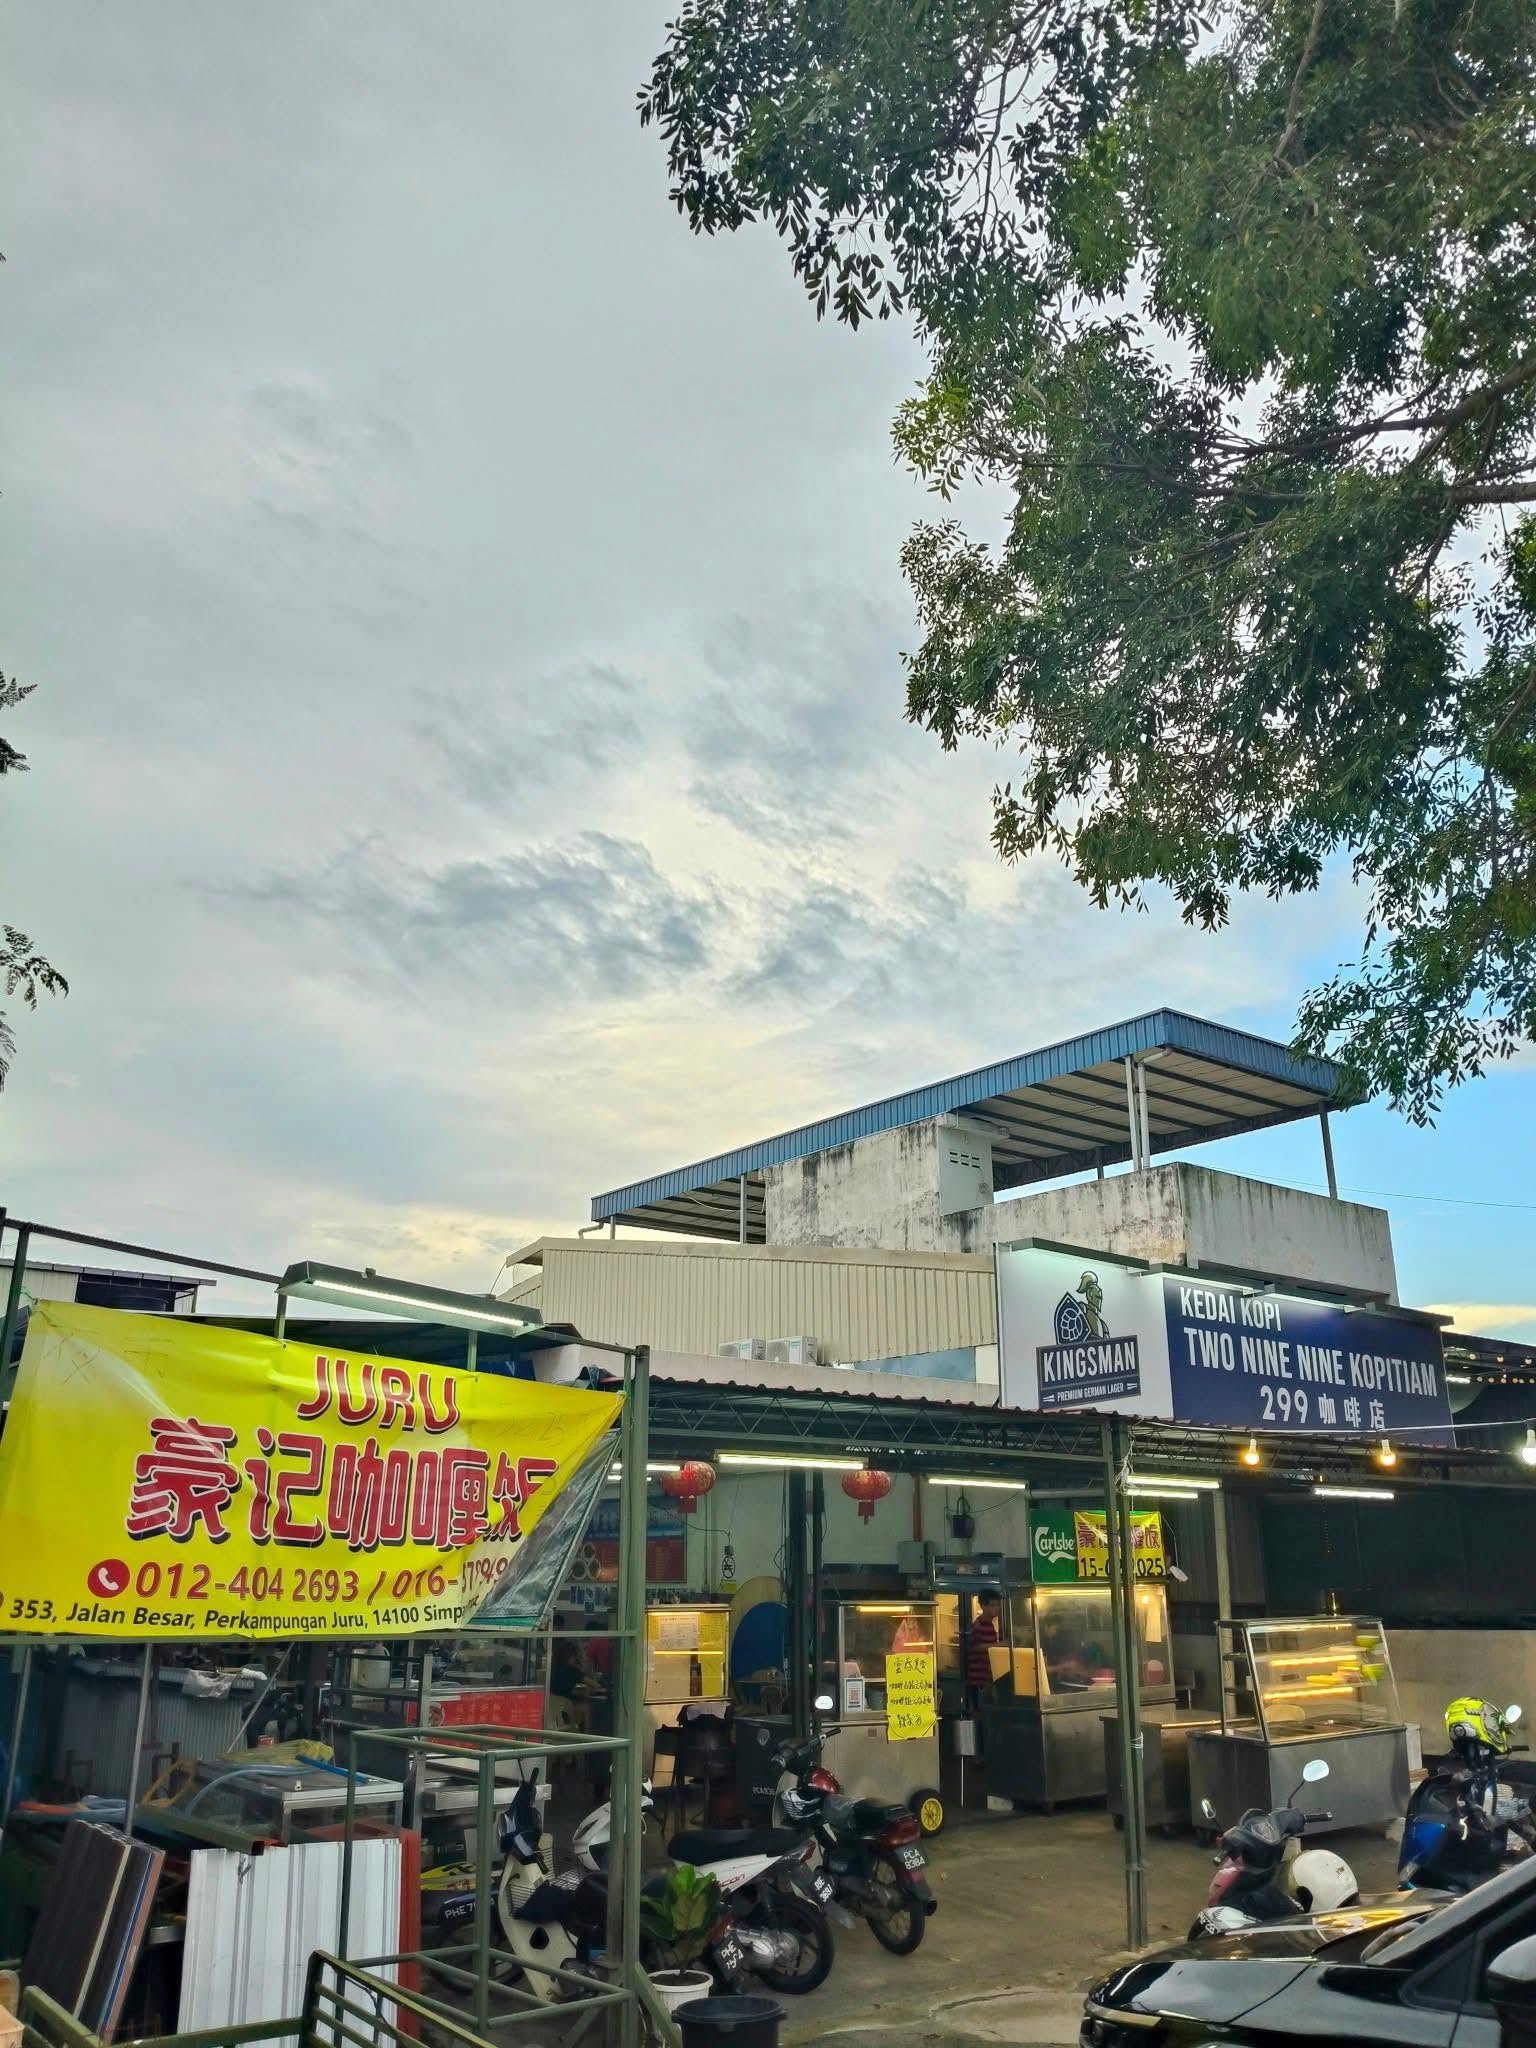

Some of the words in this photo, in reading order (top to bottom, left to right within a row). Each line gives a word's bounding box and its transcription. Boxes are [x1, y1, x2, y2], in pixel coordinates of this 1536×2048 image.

[1180, 1286, 1236, 1325] KEDAI
[1240, 1296, 1283, 1332] KOPI
[1043, 1341, 1136, 1383] KINGSMAN
[1183, 1326, 1236, 1373] TWO
[1240, 1335, 1293, 1379] NINE
[1296, 1343, 1346, 1386] NINE
[1349, 1352, 1438, 1397] KOPITIAM
[297, 1354, 461, 1433] JURU
[1057, 1388, 1083, 1402] PREMIUM
[1083, 1385, 1107, 1398] GERMAN
[1107, 1382, 1124, 1394] LAGER
[1260, 1384, 1308, 1424] 299
[1317, 1392, 1386, 1431] 咖啡店
[1034, 1526, 1075, 1557] Carlsbe
[135, 1561, 283, 1602] 012-404
[291, 1568, 360, 1603] 2693
[366, 1570, 387, 1606] /
[9, 1598, 58, 1624] 353,
[66, 1602, 126, 1625] Jalan
[133, 1606, 196, 1630] Besar,
[203, 1610, 327, 1633] Perkampungan
[331, 1611, 369, 1630] Juru,
[372, 1606, 420, 1627] 14100
[444, 1905, 467, 1919] PHE
